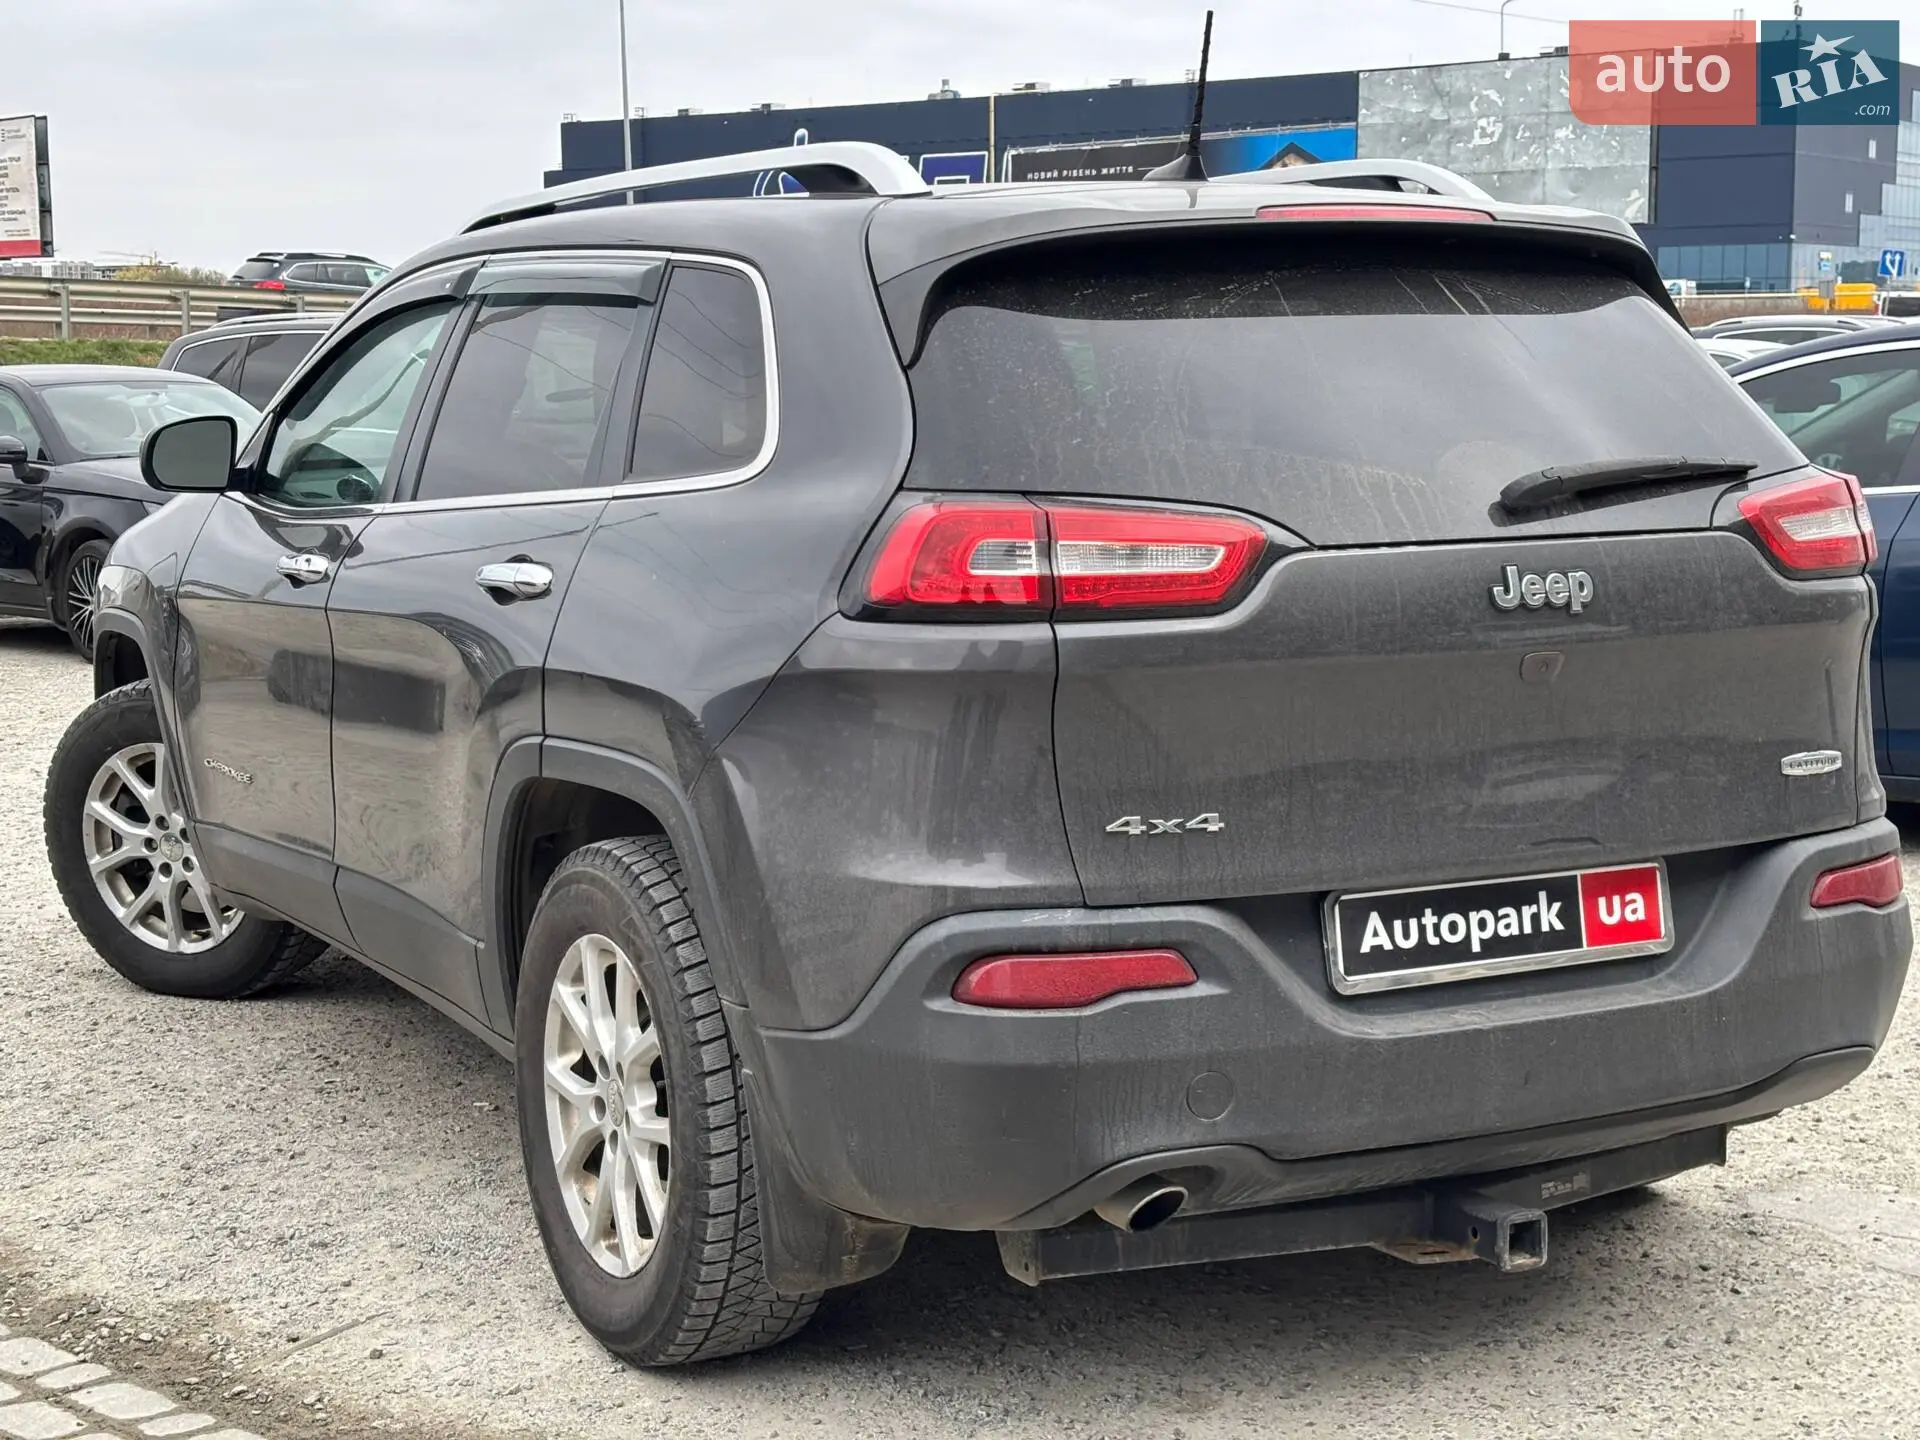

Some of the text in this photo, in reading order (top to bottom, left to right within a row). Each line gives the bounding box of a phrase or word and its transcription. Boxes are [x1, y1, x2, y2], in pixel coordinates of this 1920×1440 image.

[1027, 165, 1134, 181] НОВИЙ РІВЕНЬ ЖИТТЯ
[1491, 564, 1594, 613] Jeep
[1359, 890, 1646, 953] Autopark ua
